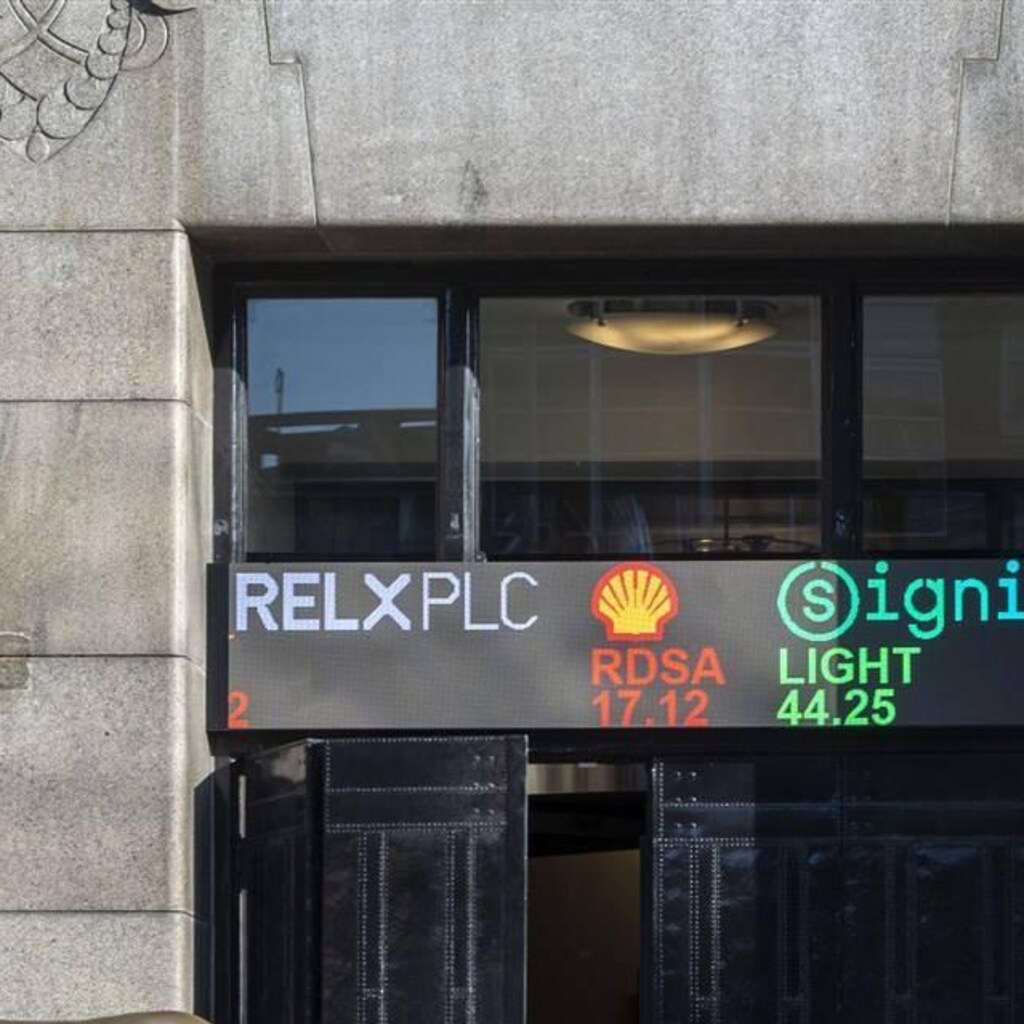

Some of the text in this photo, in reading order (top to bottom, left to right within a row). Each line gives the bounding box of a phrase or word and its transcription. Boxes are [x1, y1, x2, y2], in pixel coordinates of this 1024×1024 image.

[590, 647, 726, 686] RDSA
[779, 646, 922, 685] LIGHT
[592, 689, 710, 728] 17.12
[776, 688, 896, 726] 44.25
